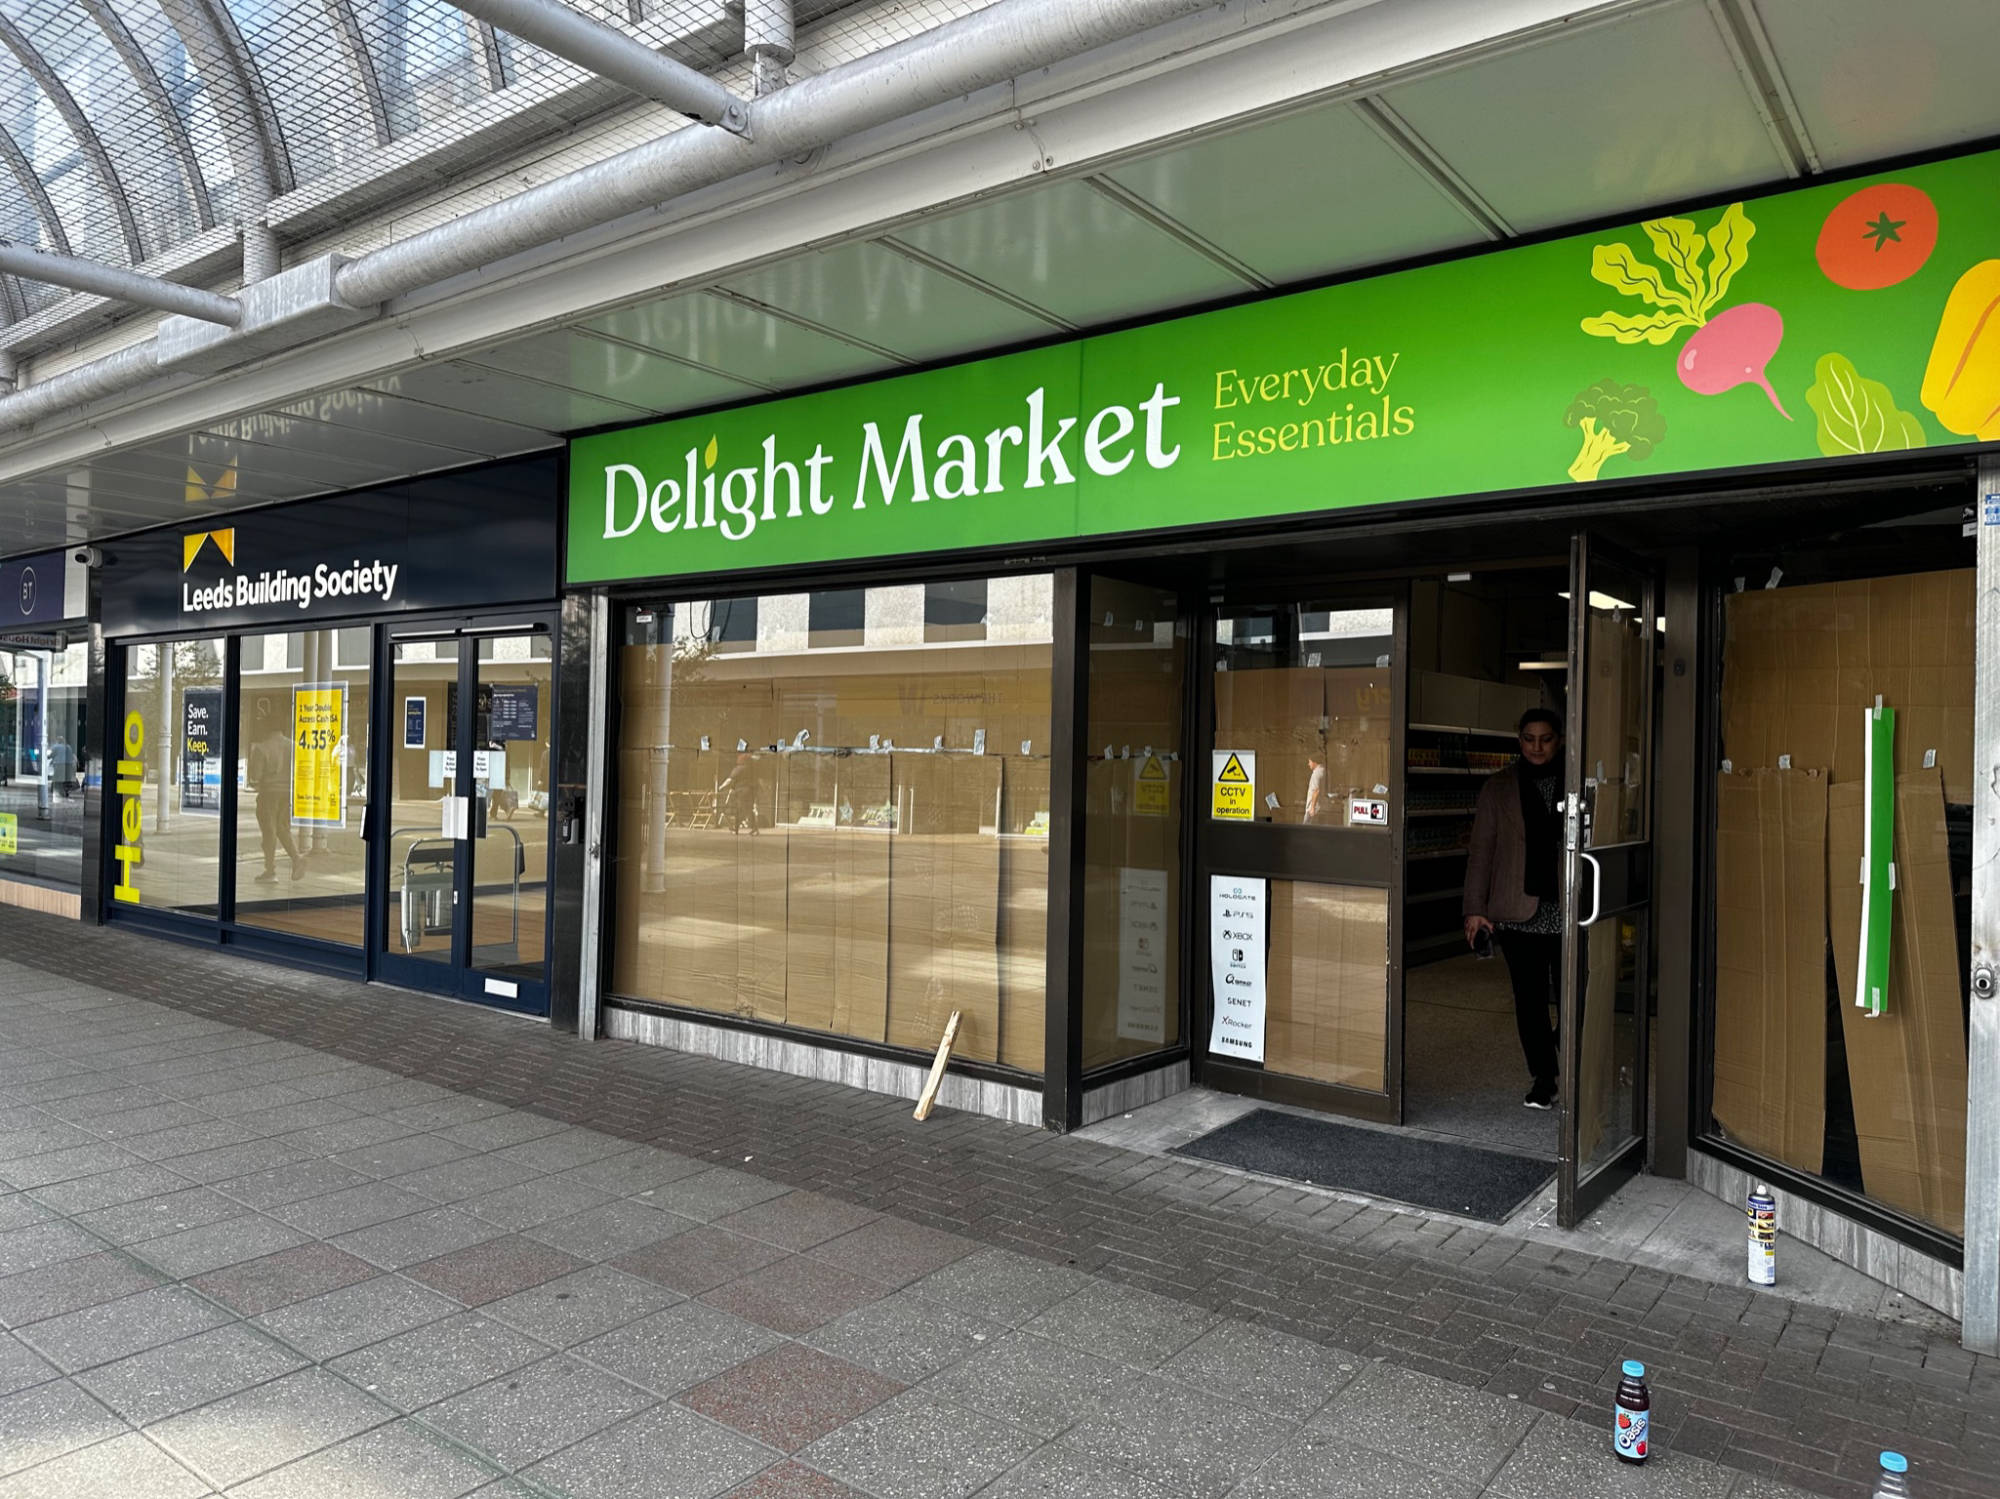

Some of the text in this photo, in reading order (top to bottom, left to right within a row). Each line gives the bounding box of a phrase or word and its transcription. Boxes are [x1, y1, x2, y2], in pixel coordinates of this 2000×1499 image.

[1214, 346, 1400, 410] Everyday
[1212, 394, 1415, 461] Essentials
[602, 382, 1181, 541] Delight Market
[23, 582, 32, 600] BT
[183, 559, 398, 612] Leeds Building Society
[187, 703, 208, 719] Save.
[187, 721, 208, 736] Earn.
[187, 737, 209, 756] Keep.
[298, 729, 336, 750] 4.35%
[1220, 787, 1246, 797] CCTV
[114, 709, 145, 904] Hello
[1216, 806, 1250, 816] operation
[1354, 806, 1369, 815] PULL
[1233, 931, 1253, 941] XBOX
[1221, 1036, 1253, 1048] SAMSUNG
[1618, 1418, 1646, 1449] Oasis
